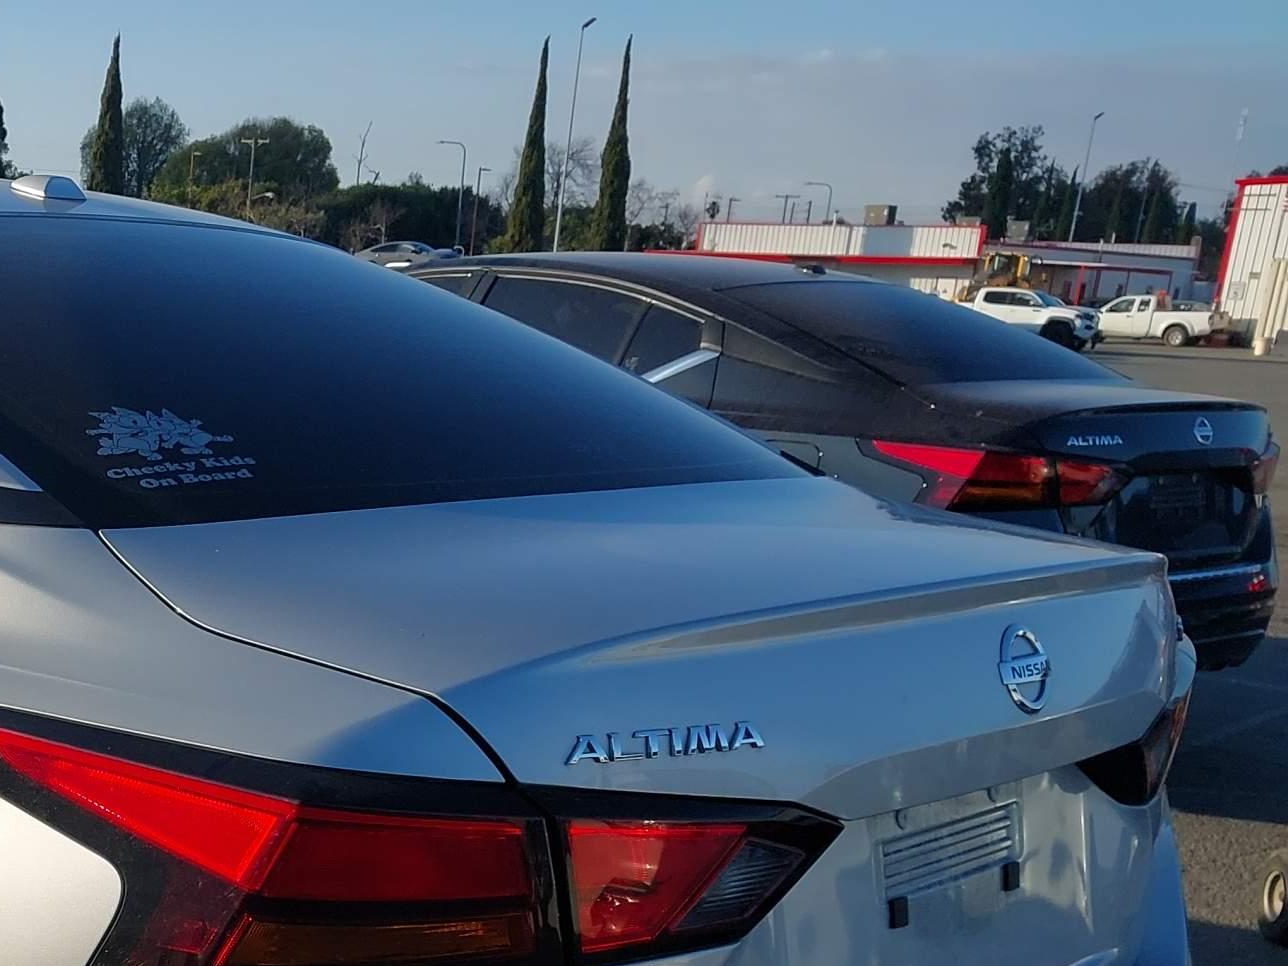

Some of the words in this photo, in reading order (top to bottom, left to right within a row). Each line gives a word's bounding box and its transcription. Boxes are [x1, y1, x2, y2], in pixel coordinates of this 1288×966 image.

[1067, 435, 1123, 446] ALTIMA
[106, 461, 196, 479] Cheeky
[200, 455, 256, 468] Kids
[139, 477, 178, 489] On
[178, 468, 255, 484] Board
[1011, 660, 1050, 679] NISSA
[564, 720, 765, 766] ALTIMA
